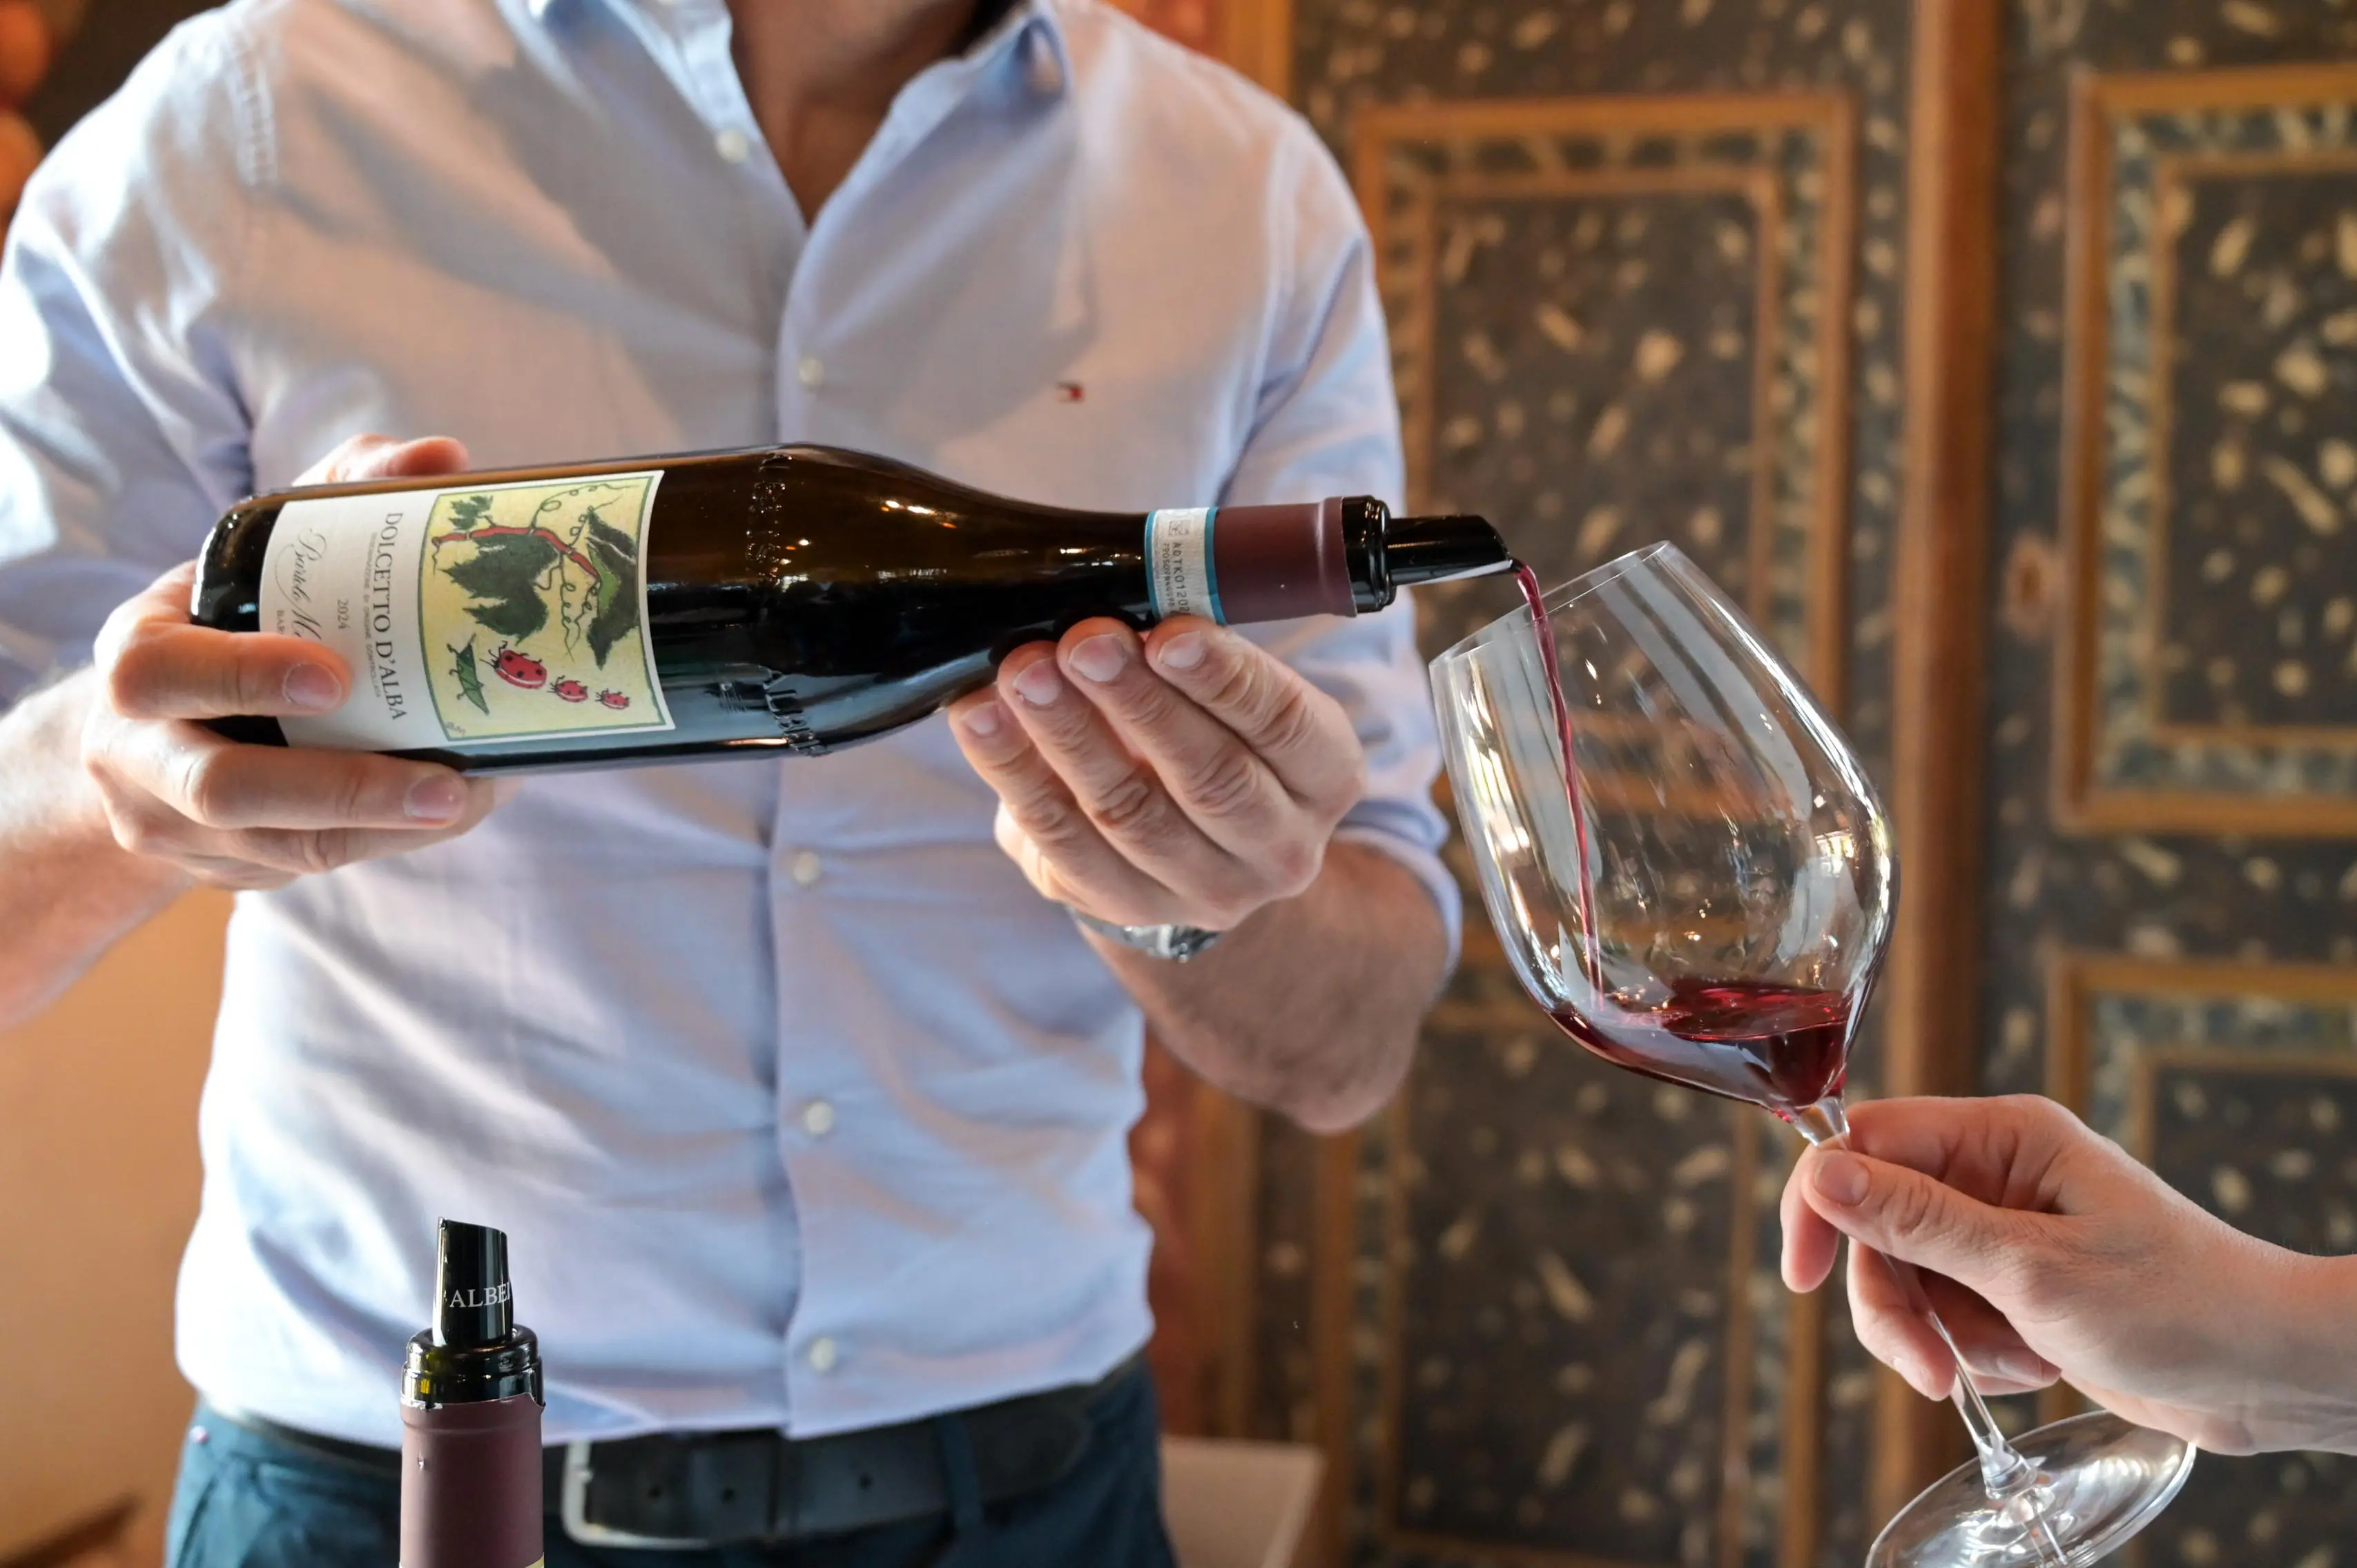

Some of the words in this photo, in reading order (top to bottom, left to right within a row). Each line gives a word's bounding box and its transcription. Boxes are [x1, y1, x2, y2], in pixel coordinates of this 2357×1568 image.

[290, 528, 327, 603] Bartolo
[374, 512, 404, 632] DOLCETTO
[337, 599, 349, 629] 2024
[365, 644, 380, 697] CONTROLLATA
[376, 641, 407, 720] D'ALBA
